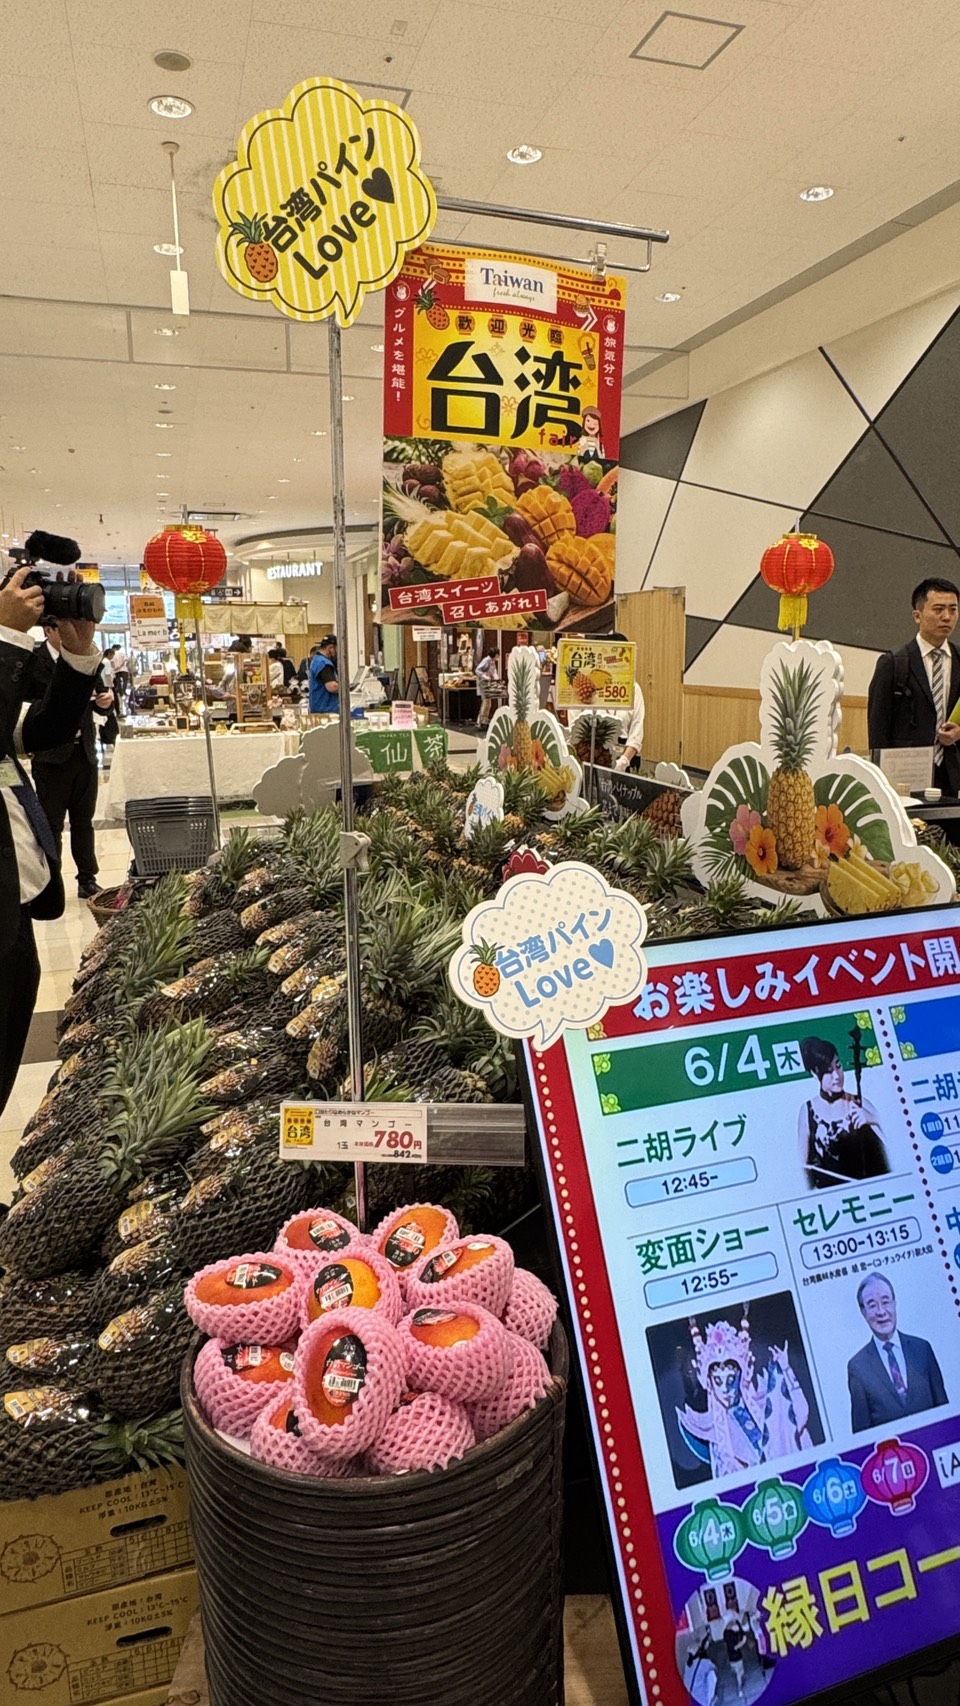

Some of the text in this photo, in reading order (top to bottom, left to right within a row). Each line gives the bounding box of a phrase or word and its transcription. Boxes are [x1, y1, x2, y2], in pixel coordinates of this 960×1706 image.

[262, 127, 376, 254] 台湾パイン
[292, 199, 377, 281] Love
[480, 267, 544, 294] Taiwan
[603, 336, 617, 387] 旅気分で
[426, 340, 583, 446] 台湾
[538, 428, 577, 449] fair
[398, 580, 494, 605] 台湾スイーツ
[449, 594, 541, 619] 召しあがれ！
[571, 651, 596, 668] 台湾
[604, 685, 627, 698] 580
[494, 908, 612, 978] 台湾パイン
[514, 957, 593, 1008] Love
[912, 1071, 960, 1104] 二胡
[287, 1125, 311, 1139] 台湾
[324, 1119, 412, 1128] 台湾マンゴー
[337, 1141, 349, 1150] 1玉
[374, 1130, 422, 1150] 780円
[617, 1113, 747, 1167] 二胡ライブ
[793, 1192, 915, 1236] セレモニー
[635, 1226, 770, 1275] 変面ショー
[813, 1224, 910, 1261] 13:00-13:15
[80, 1503, 103, 1514] KEEP
[762, 1546, 960, 1658] 縁日コー
[87, 1615, 109, 1626] KEEP
